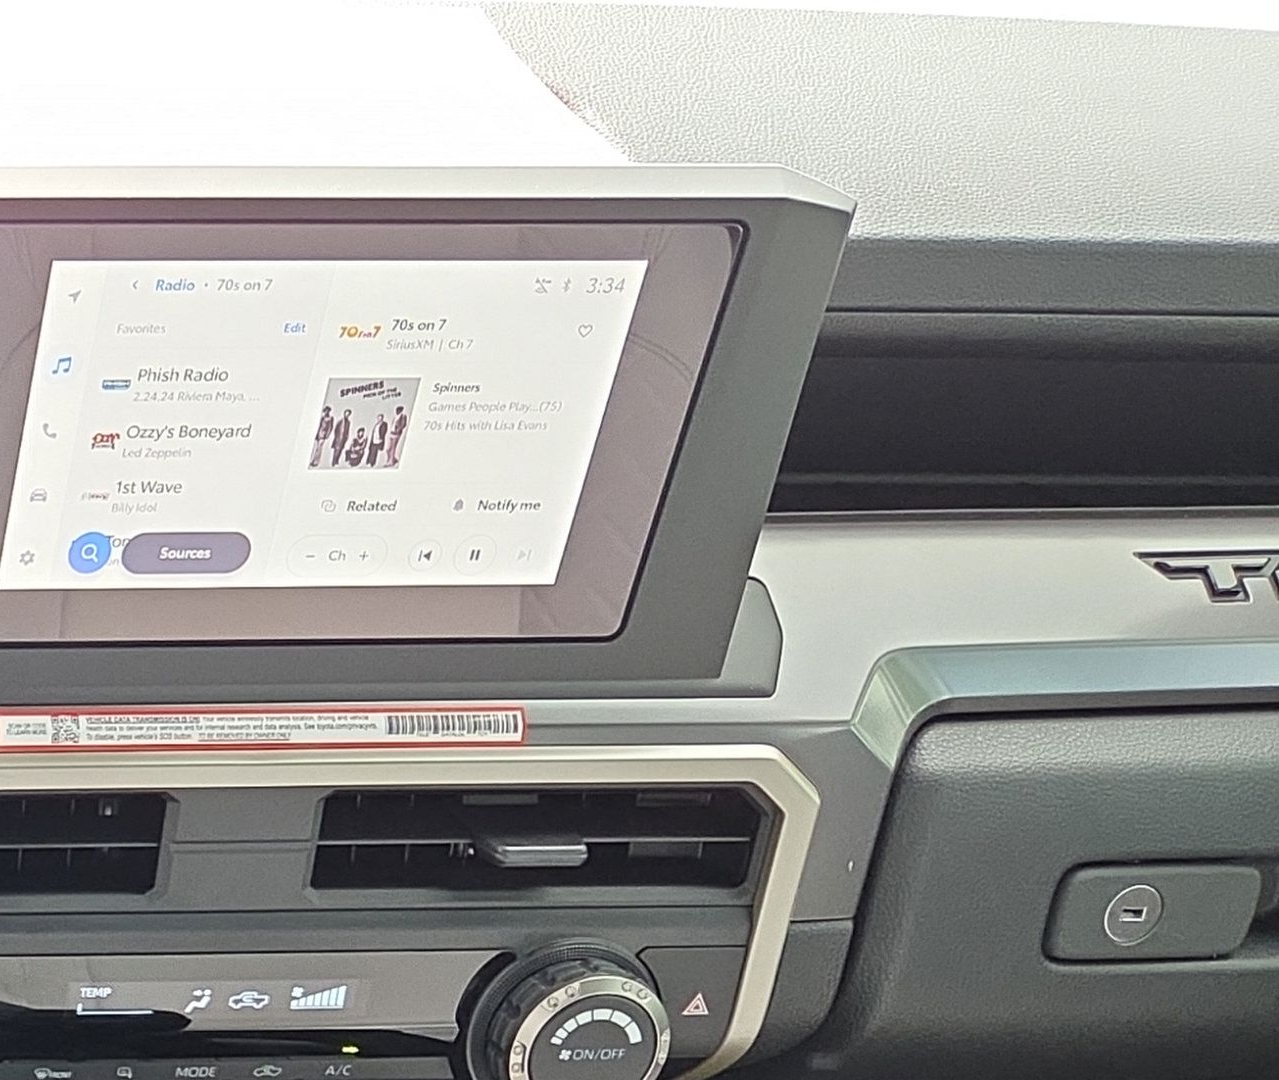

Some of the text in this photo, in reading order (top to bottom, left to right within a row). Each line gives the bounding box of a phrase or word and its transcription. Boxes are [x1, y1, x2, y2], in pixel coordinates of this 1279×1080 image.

[155, 279, 273, 292] Radio 70s on 7
[586, 277, 625, 294] 3:34
[116, 323, 166, 335] Favorites
[283, 323, 306, 333] Edit
[392, 318, 447, 331] 70s on 7
[386, 339, 473, 350] SiriusXM Ch 7
[137, 368, 229, 382] Phish Radio
[340, 380, 385, 397] SPINNERS
[432, 382, 481, 395] Spinners
[177, 392, 213, 402] Riviera
[428, 401, 466, 412] Games
[468, 401, 506, 413] People
[424, 420, 547, 431] 70s Hits with Lisa Evans
[126, 425, 174, 442] Ozzy's
[179, 424, 252, 441] Boneyard
[122, 447, 191, 460] Led Zeppelin
[116, 480, 183, 494] 1st Wave
[111, 502, 157, 515] Billy Idol
[347, 500, 396, 512] Related
[477, 499, 541, 514] Notify me
[158, 547, 211, 560] Sources
[328, 549, 346, 561] Ch
[80, 987, 113, 998] TEMP
[572, 1048, 626, 1061] ON/OFF
[49, 1070, 72, 1078] FRONT
[175, 1066, 217, 1078] MODE
[324, 1065, 351, 1077] A/C
